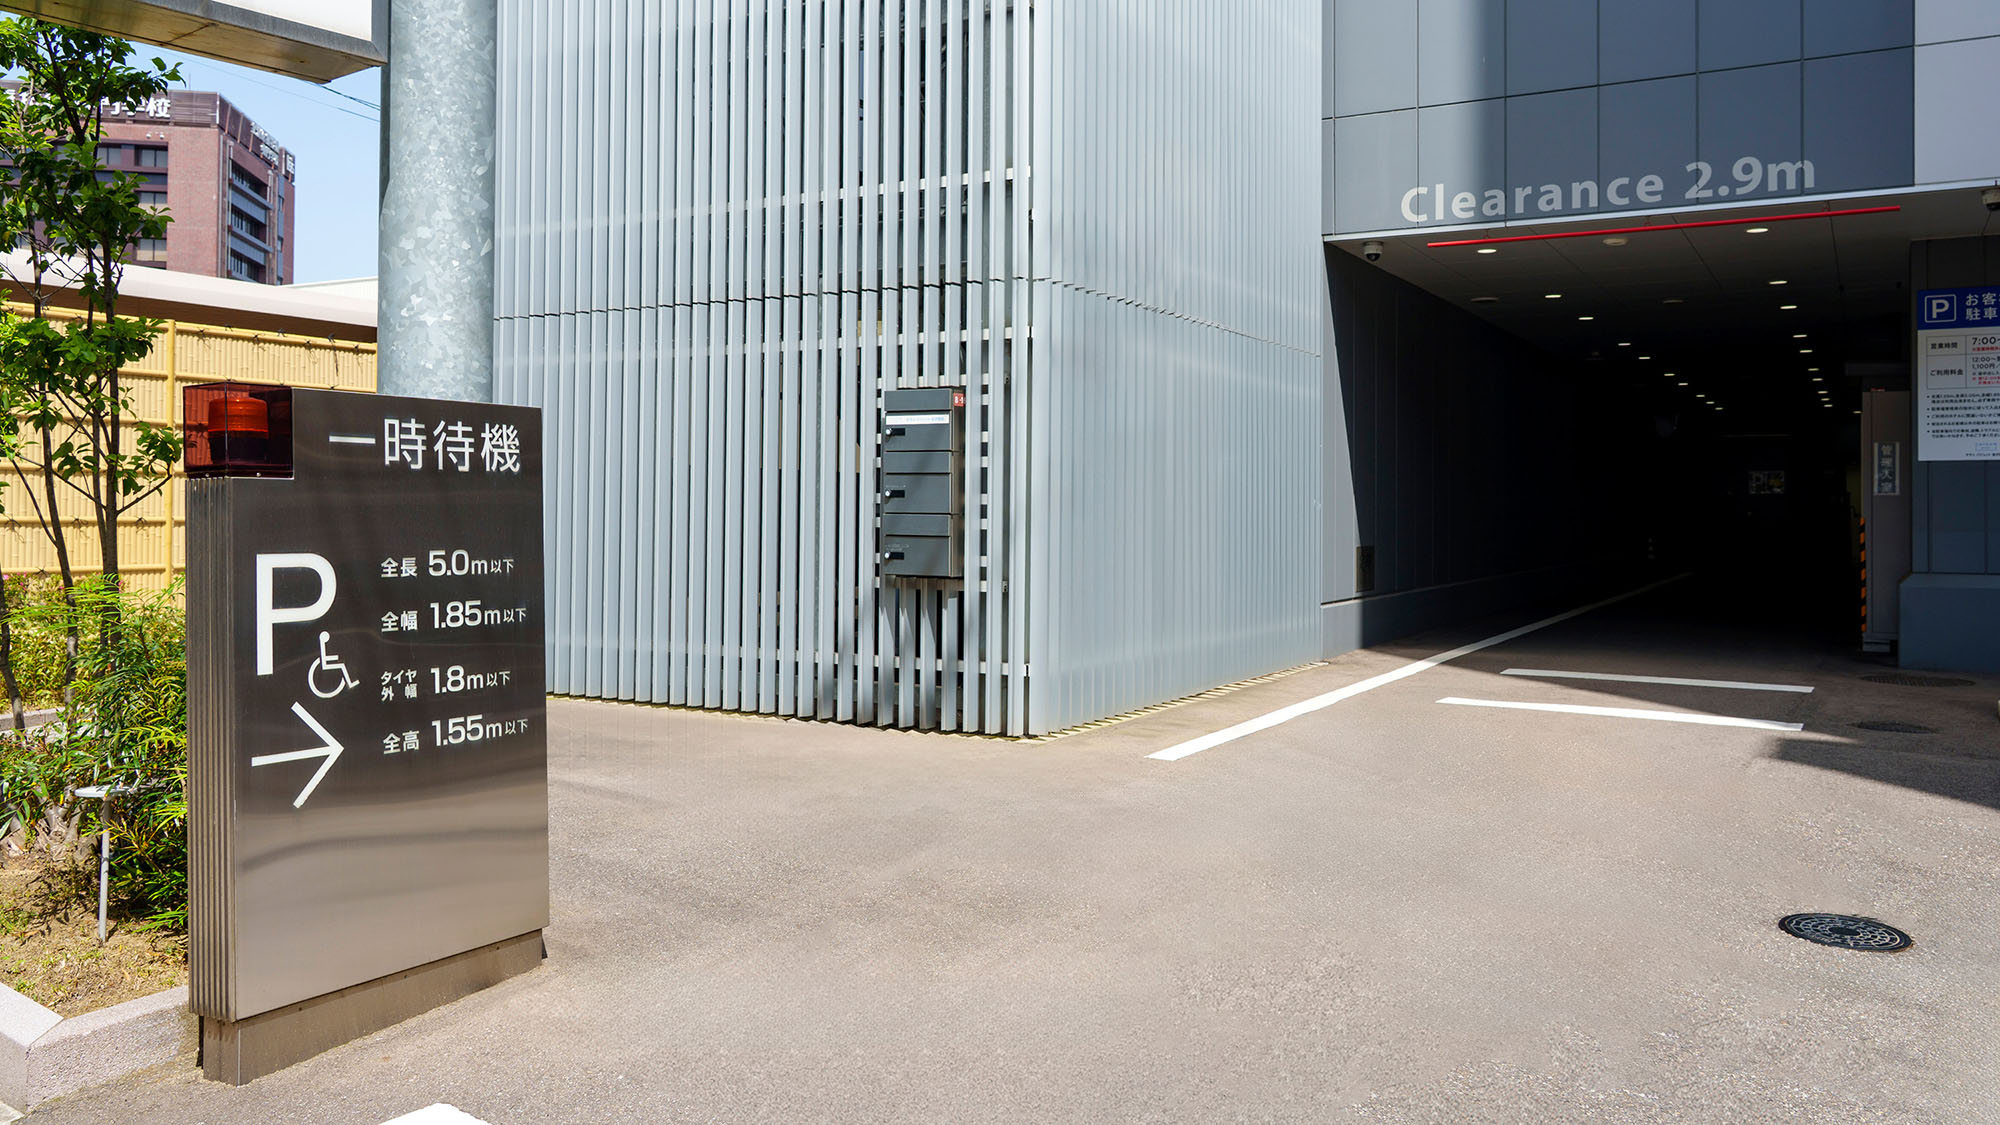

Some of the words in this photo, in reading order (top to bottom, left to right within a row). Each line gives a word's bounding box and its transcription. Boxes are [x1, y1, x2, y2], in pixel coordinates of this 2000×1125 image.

[1400, 173, 1664, 224] Clearance
[1684, 156, 1815, 200] 2.9m
[1931, 299, 1950, 319] P
[1965, 292, 2000, 306] お客
[328, 418, 521, 473] 一時待機
[380, 557, 418, 578] 全長
[256, 552, 337, 676] P
[381, 610, 418, 632] 全幅
[380, 669, 417, 685] タイヤ
[383, 730, 420, 755] 全高
